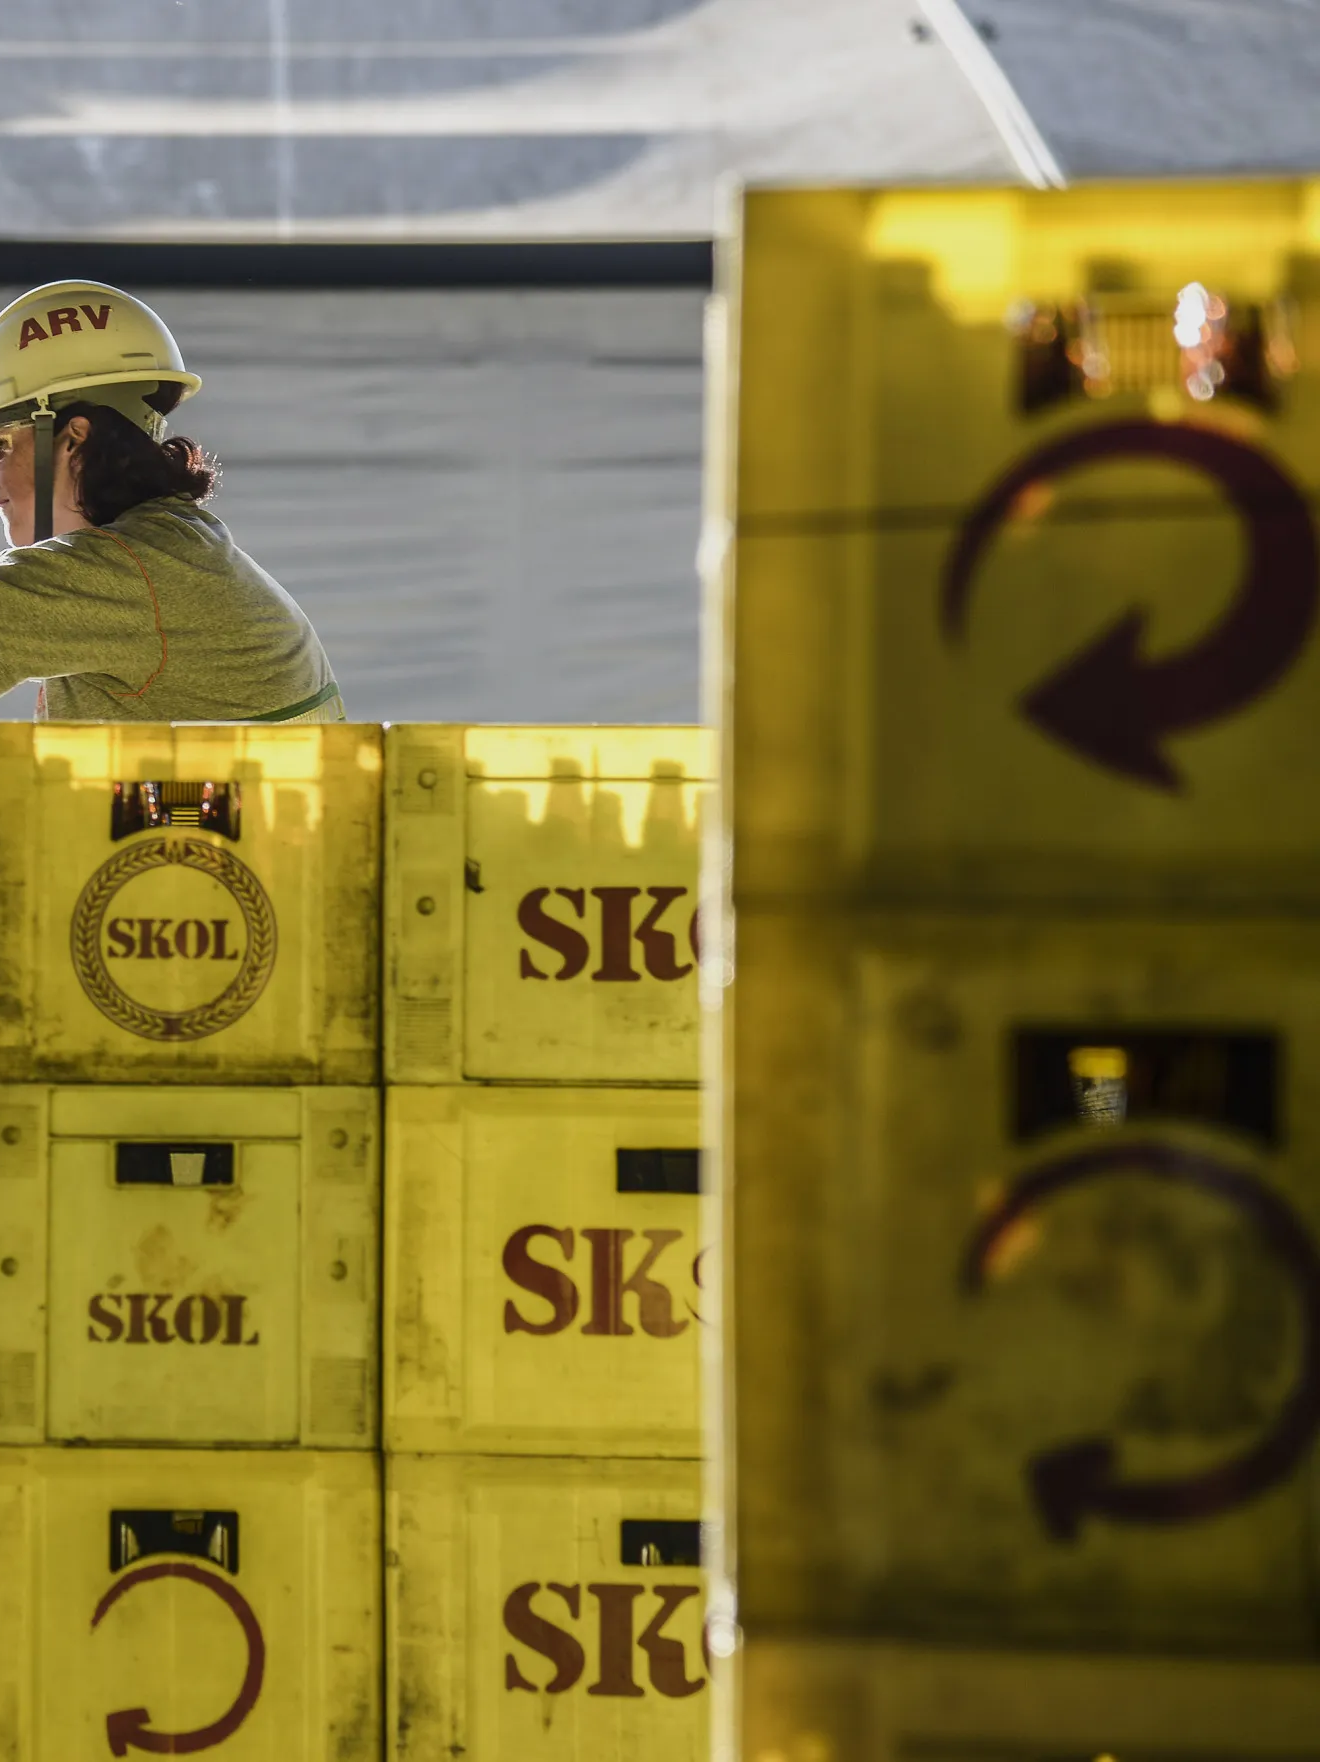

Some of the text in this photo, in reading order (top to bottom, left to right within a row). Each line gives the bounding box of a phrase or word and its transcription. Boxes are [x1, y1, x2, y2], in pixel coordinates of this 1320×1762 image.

[18, 304, 113, 350] ARV
[106, 917, 239, 961] SKOL
[517, 886, 700, 982] SK
[502, 1224, 702, 1338] SK
[87, 1292, 260, 1346] SKOL
[503, 1582, 710, 1698] SK
